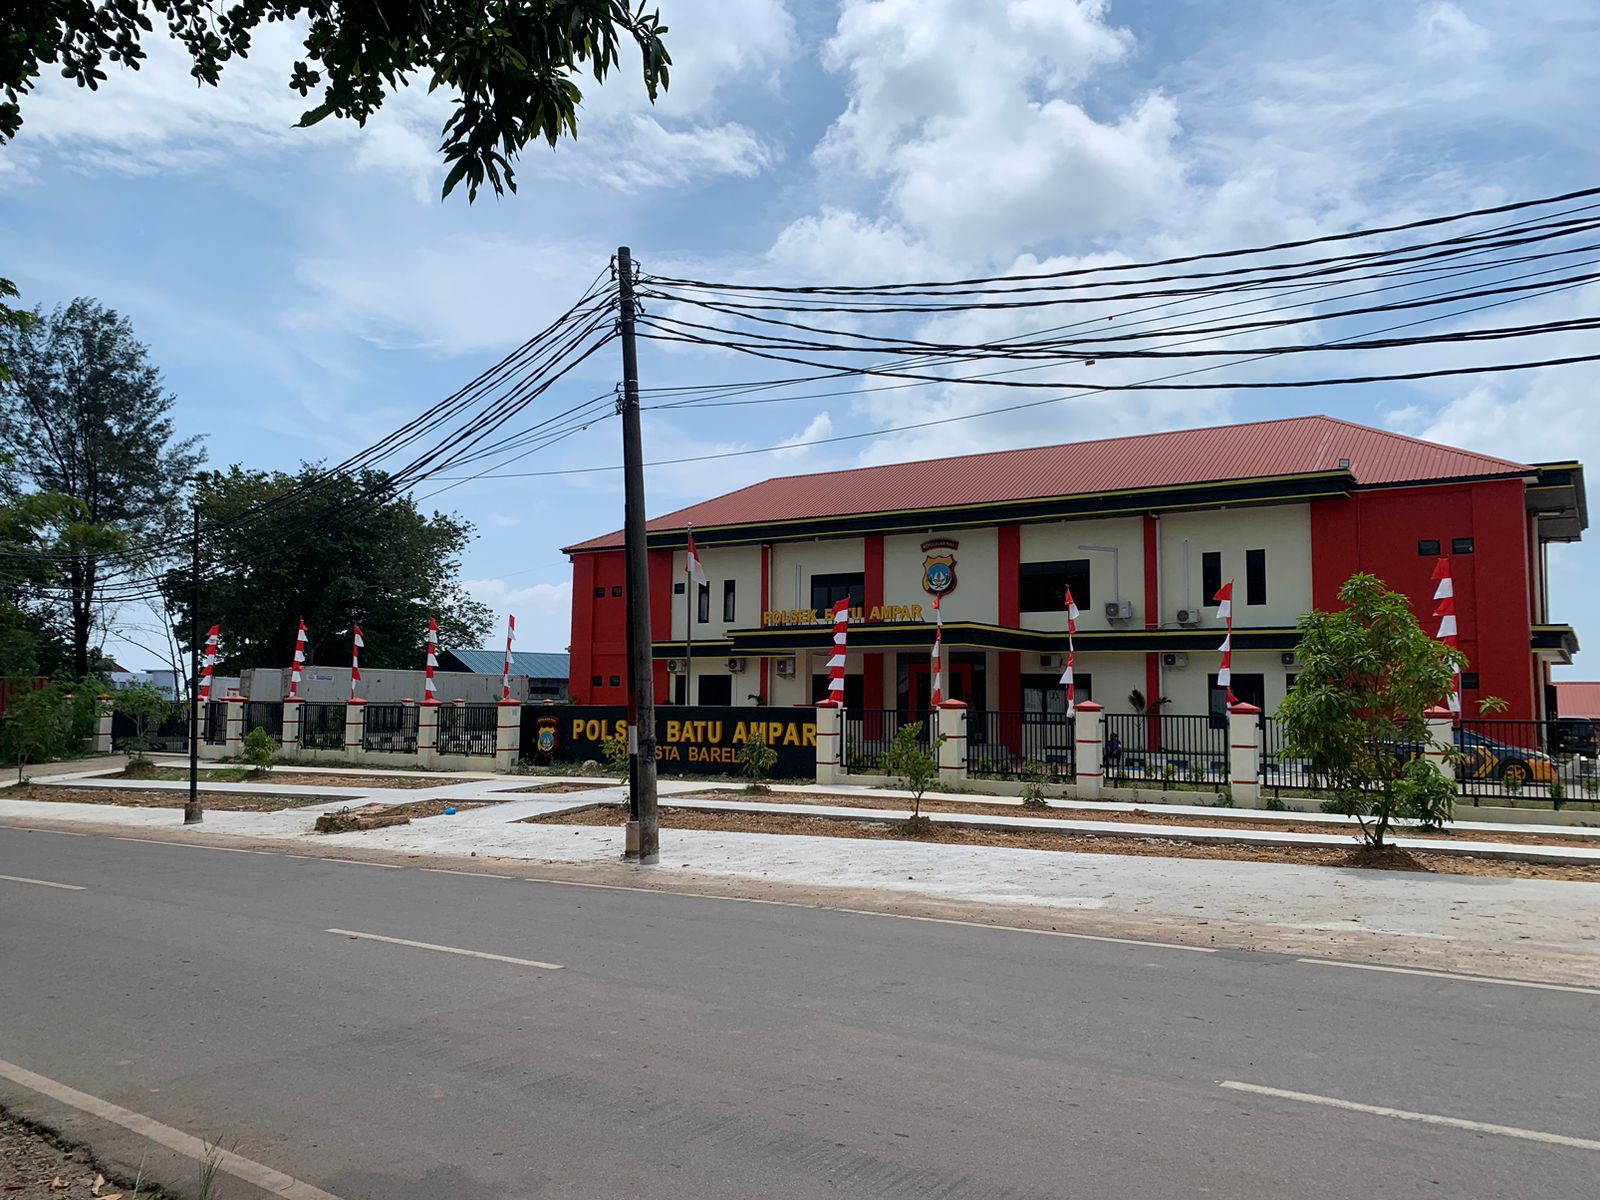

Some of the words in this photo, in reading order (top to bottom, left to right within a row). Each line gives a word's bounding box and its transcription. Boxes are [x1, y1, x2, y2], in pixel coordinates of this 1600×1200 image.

[763, 608, 818, 625] POLSEK
[824, 606, 863, 622] BU
[870, 604, 922, 620] AMPAR
[572, 719, 657, 742] POLS
[666, 720, 723, 743] BATU
